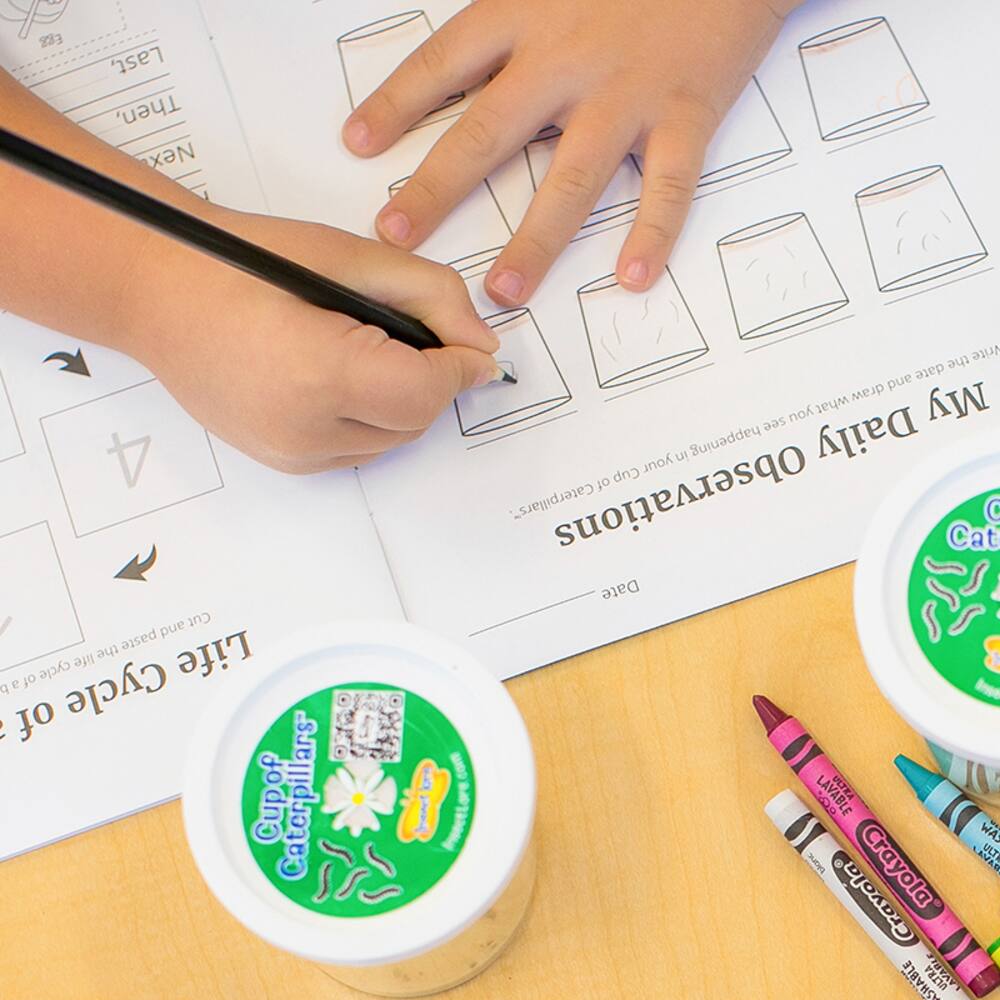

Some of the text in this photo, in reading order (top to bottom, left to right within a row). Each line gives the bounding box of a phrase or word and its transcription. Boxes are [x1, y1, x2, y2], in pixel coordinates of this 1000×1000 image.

[110, 46, 165, 75] Last,
[115, 94, 183, 125] Then,
[916, 363, 945, 380] date
[948, 355, 970, 370] the
[852, 382, 885, 401] draw
[887, 373, 912, 390] and
[789, 406, 814, 421] you
[816, 394, 849, 415] what
[764, 418, 787, 432] see
[690, 429, 761, 457] happening
[106, 432, 152, 489] 4
[554, 381, 990, 547] My Daily Observations
[643, 453, 674, 473] your
[676, 451, 689, 463] in
[598, 475, 610, 491] of
[614, 466, 640, 483] Cup
[600, 579, 640, 601] Date
[161, 618, 185, 637] and
[189, 611, 211, 628] Cut
[97, 638, 121, 658] the
[122, 628, 157, 650] paste
[74, 647, 95, 667] life
[177, 630, 253, 677] Life
[22, 673, 36, 689] of
[39, 660, 71, 682] cycle
[66, 661, 167, 715] Cycle
[15, 702, 54, 742] of
[255, 754, 287, 841] Cup of
[816, 774, 854, 818] LAVABLE
[832, 774, 855, 800] ULTRA
[807, 852, 826, 875] blanc
[863, 824, 934, 909] Crayola
[845, 860, 914, 941] Crayola
[924, 964, 948, 990] ULTRA
